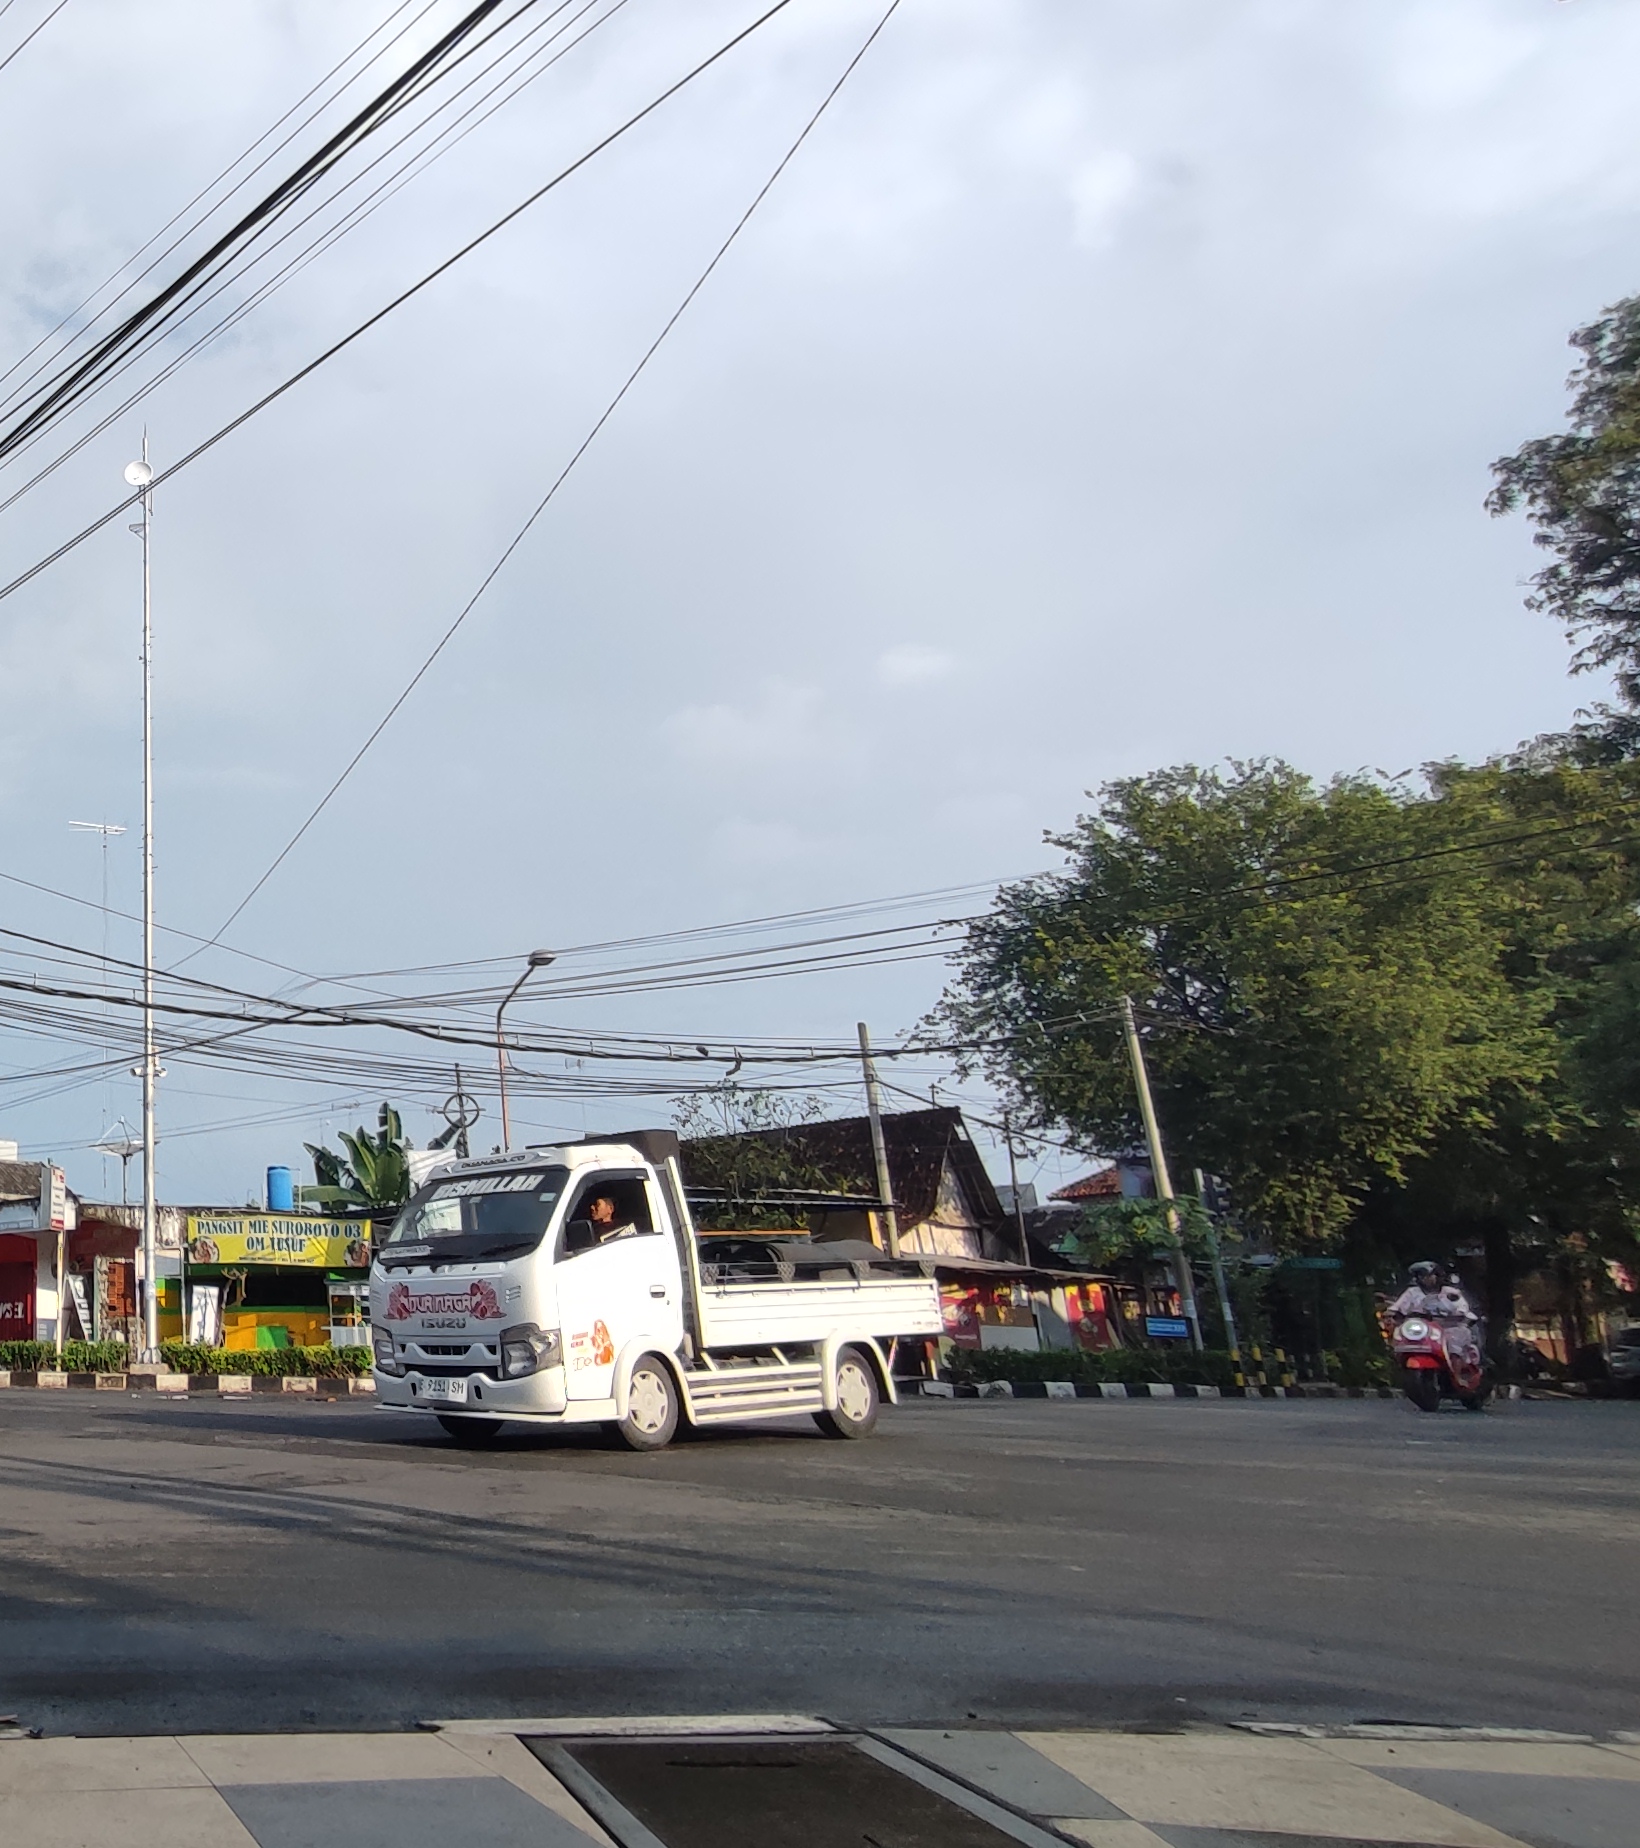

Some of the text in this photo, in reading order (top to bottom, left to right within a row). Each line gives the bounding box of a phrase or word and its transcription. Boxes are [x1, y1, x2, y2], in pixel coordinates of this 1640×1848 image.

[430, 1174, 546, 1201] BISMILLAH
[197, 1219, 361, 1238] PANGSIT MIE SUROBOYO 03
[246, 1236, 306, 1253] OM YUSUF
[421, 1317, 467, 1329] ISUZU
